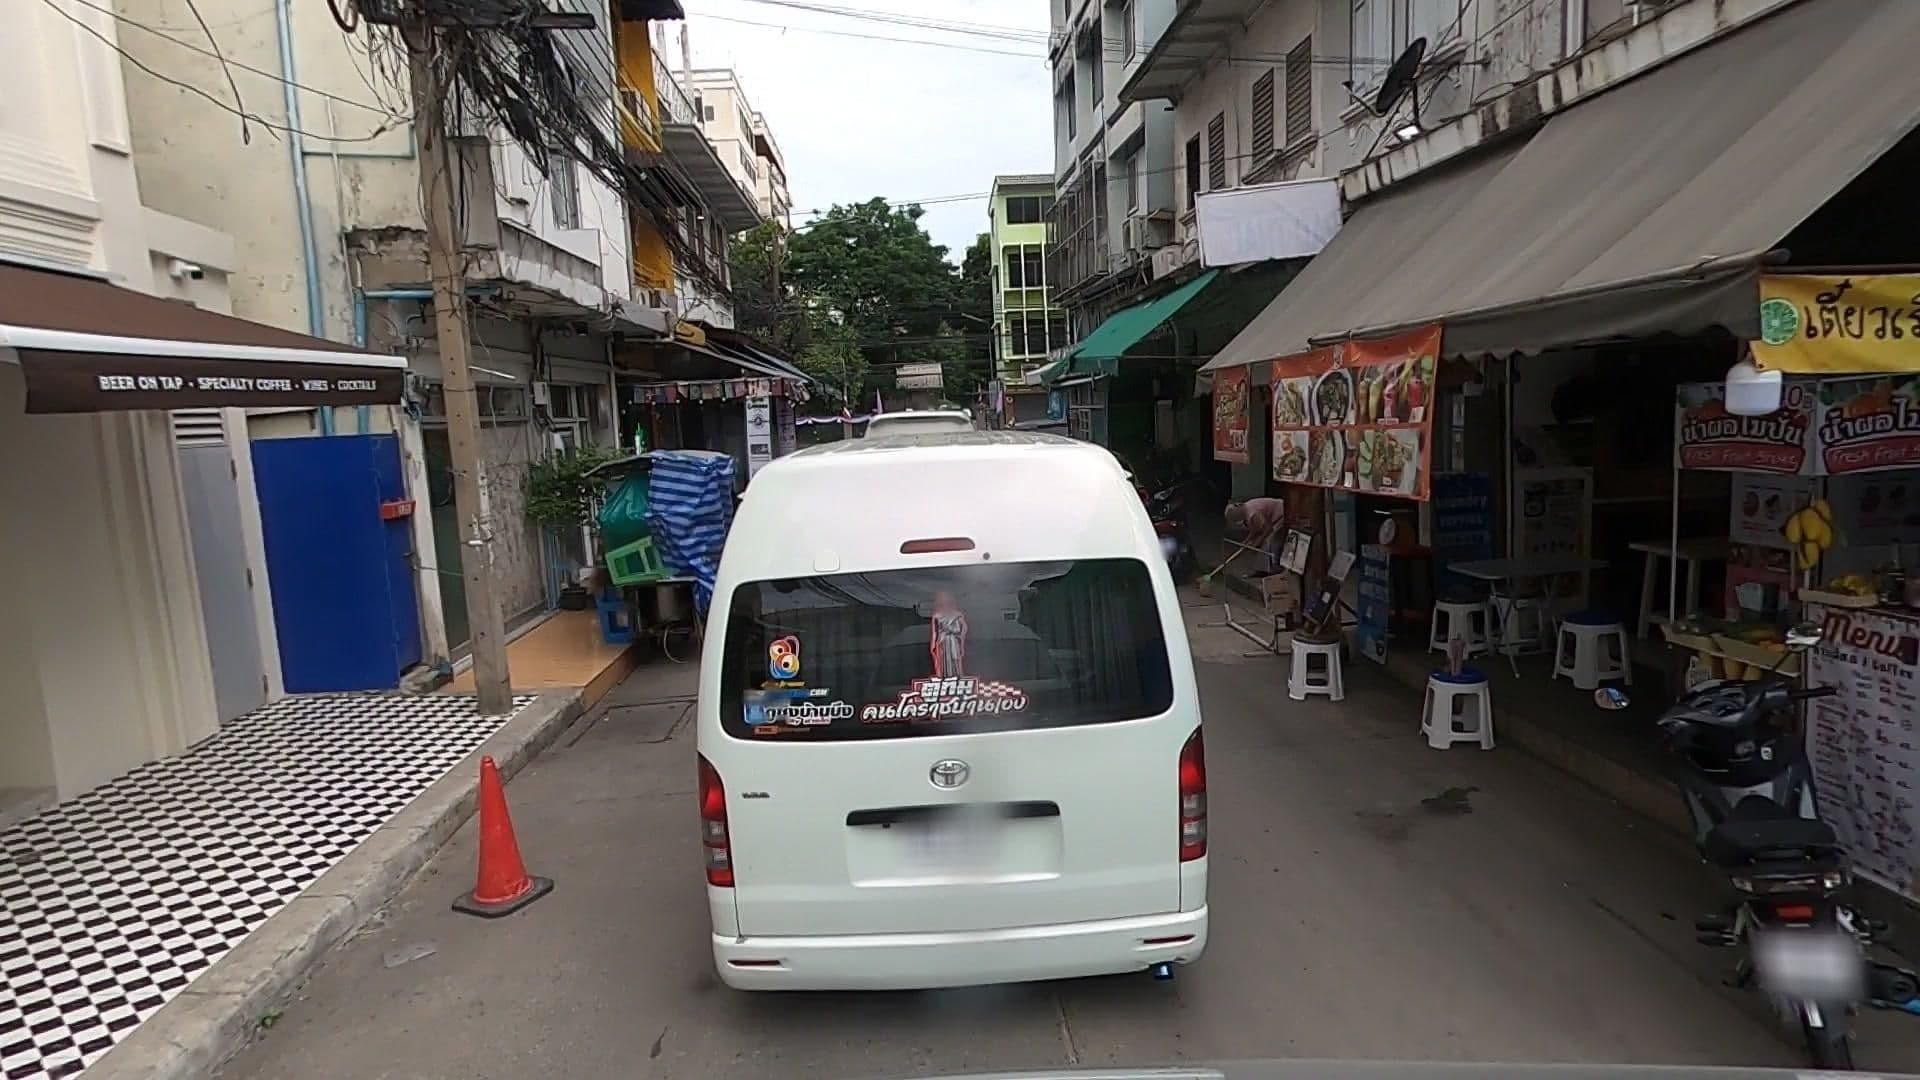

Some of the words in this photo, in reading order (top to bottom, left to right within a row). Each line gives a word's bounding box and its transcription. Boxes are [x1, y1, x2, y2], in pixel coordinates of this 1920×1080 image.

[98, 376, 136, 390] BEER
[138, 376, 158, 390] ON
[159, 376, 183, 390] TAP
[197, 377, 254, 391] SPECIALTY
[256, 378, 292, 391] COFFEE
